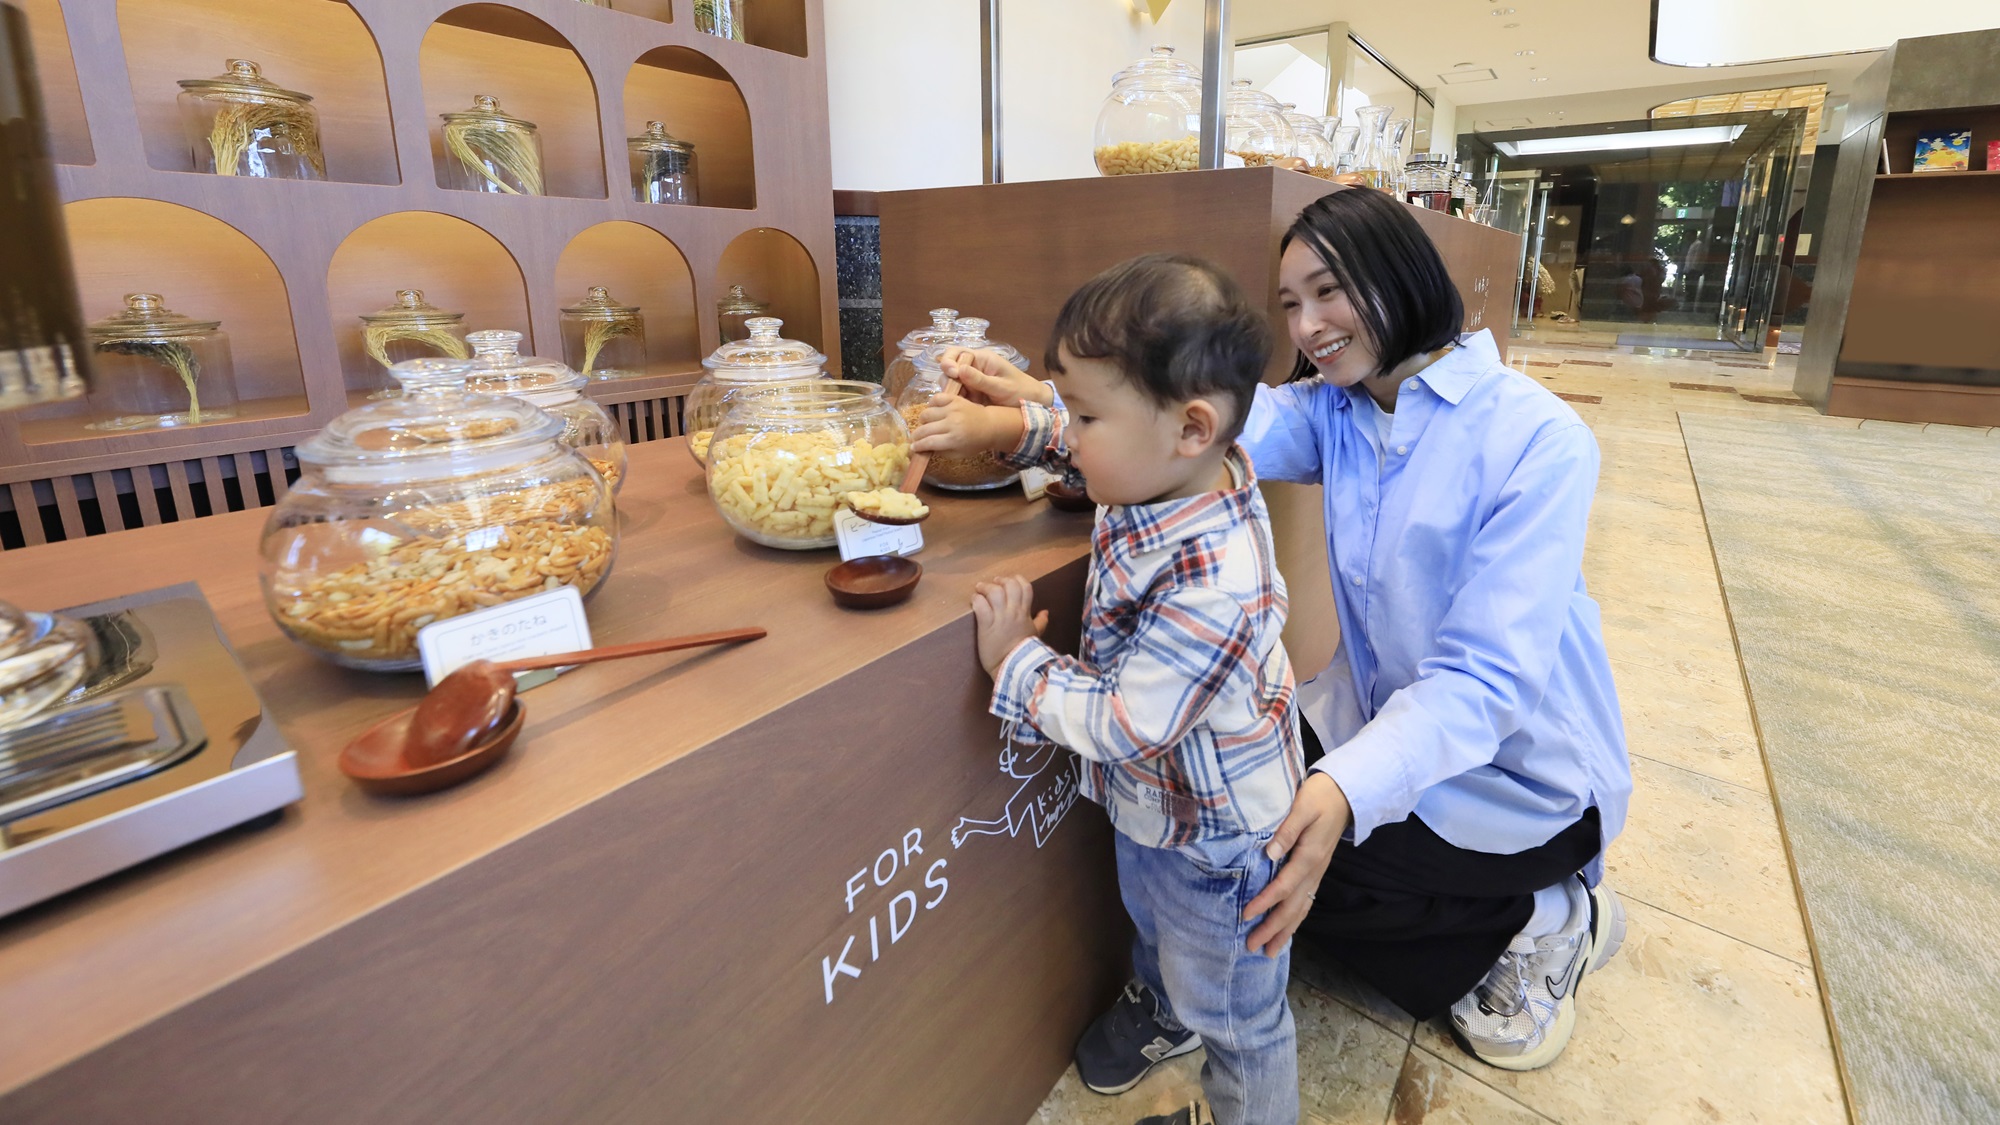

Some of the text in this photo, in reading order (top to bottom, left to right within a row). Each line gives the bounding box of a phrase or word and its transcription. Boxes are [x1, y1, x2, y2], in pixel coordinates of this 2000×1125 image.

[471, 615, 547, 646] かきのたね
[844, 827, 924, 914] FOR
[822, 858, 950, 1005] KIDS
